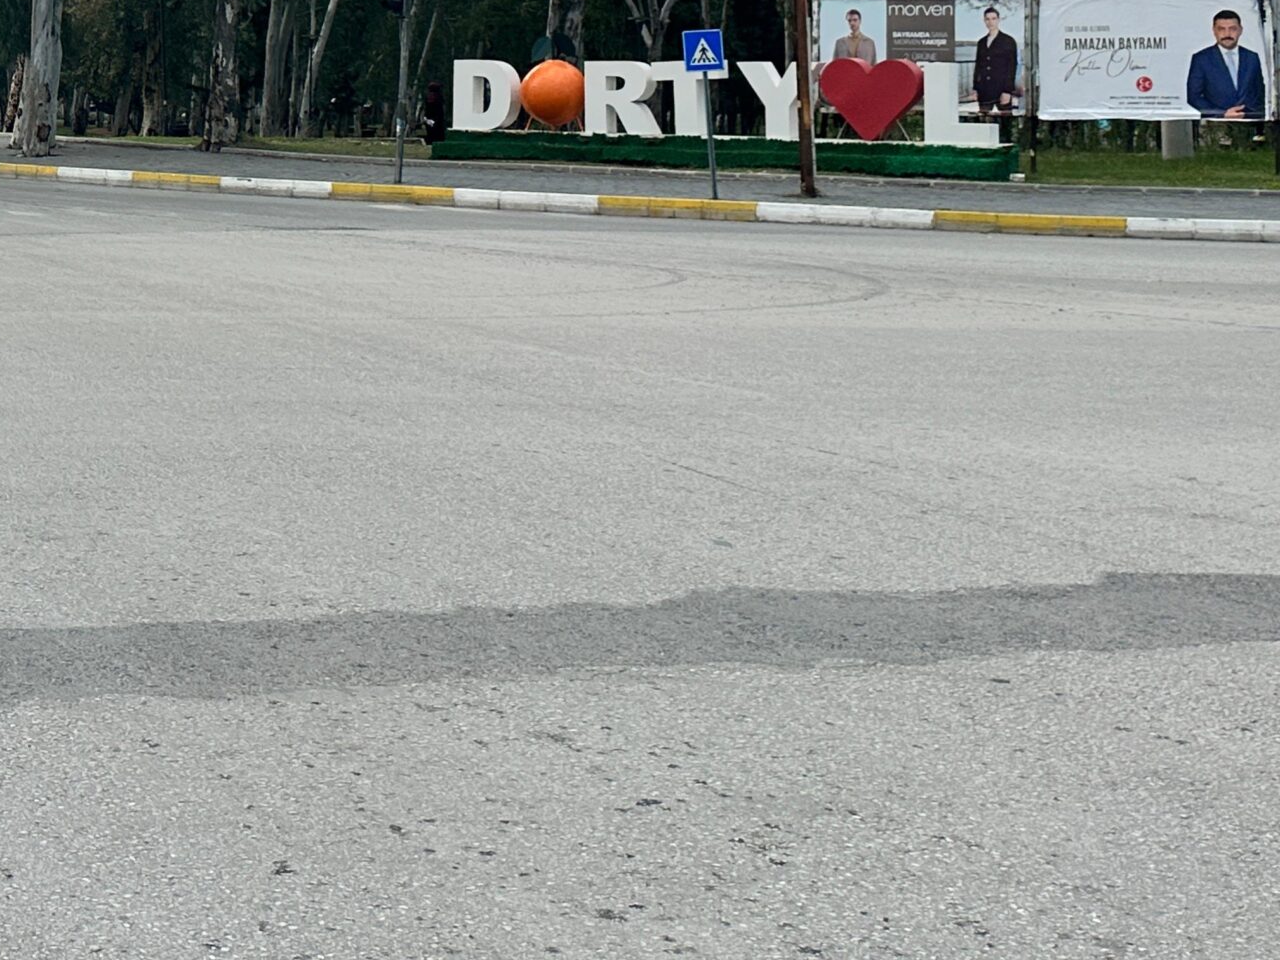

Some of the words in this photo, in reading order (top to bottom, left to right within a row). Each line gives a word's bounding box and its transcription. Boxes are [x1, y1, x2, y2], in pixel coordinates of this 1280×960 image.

[888, 4, 953, 16] morven
[1064, 37, 1115, 51] RAMAZAN
[1118, 37, 1167, 50] BAYRAMI
